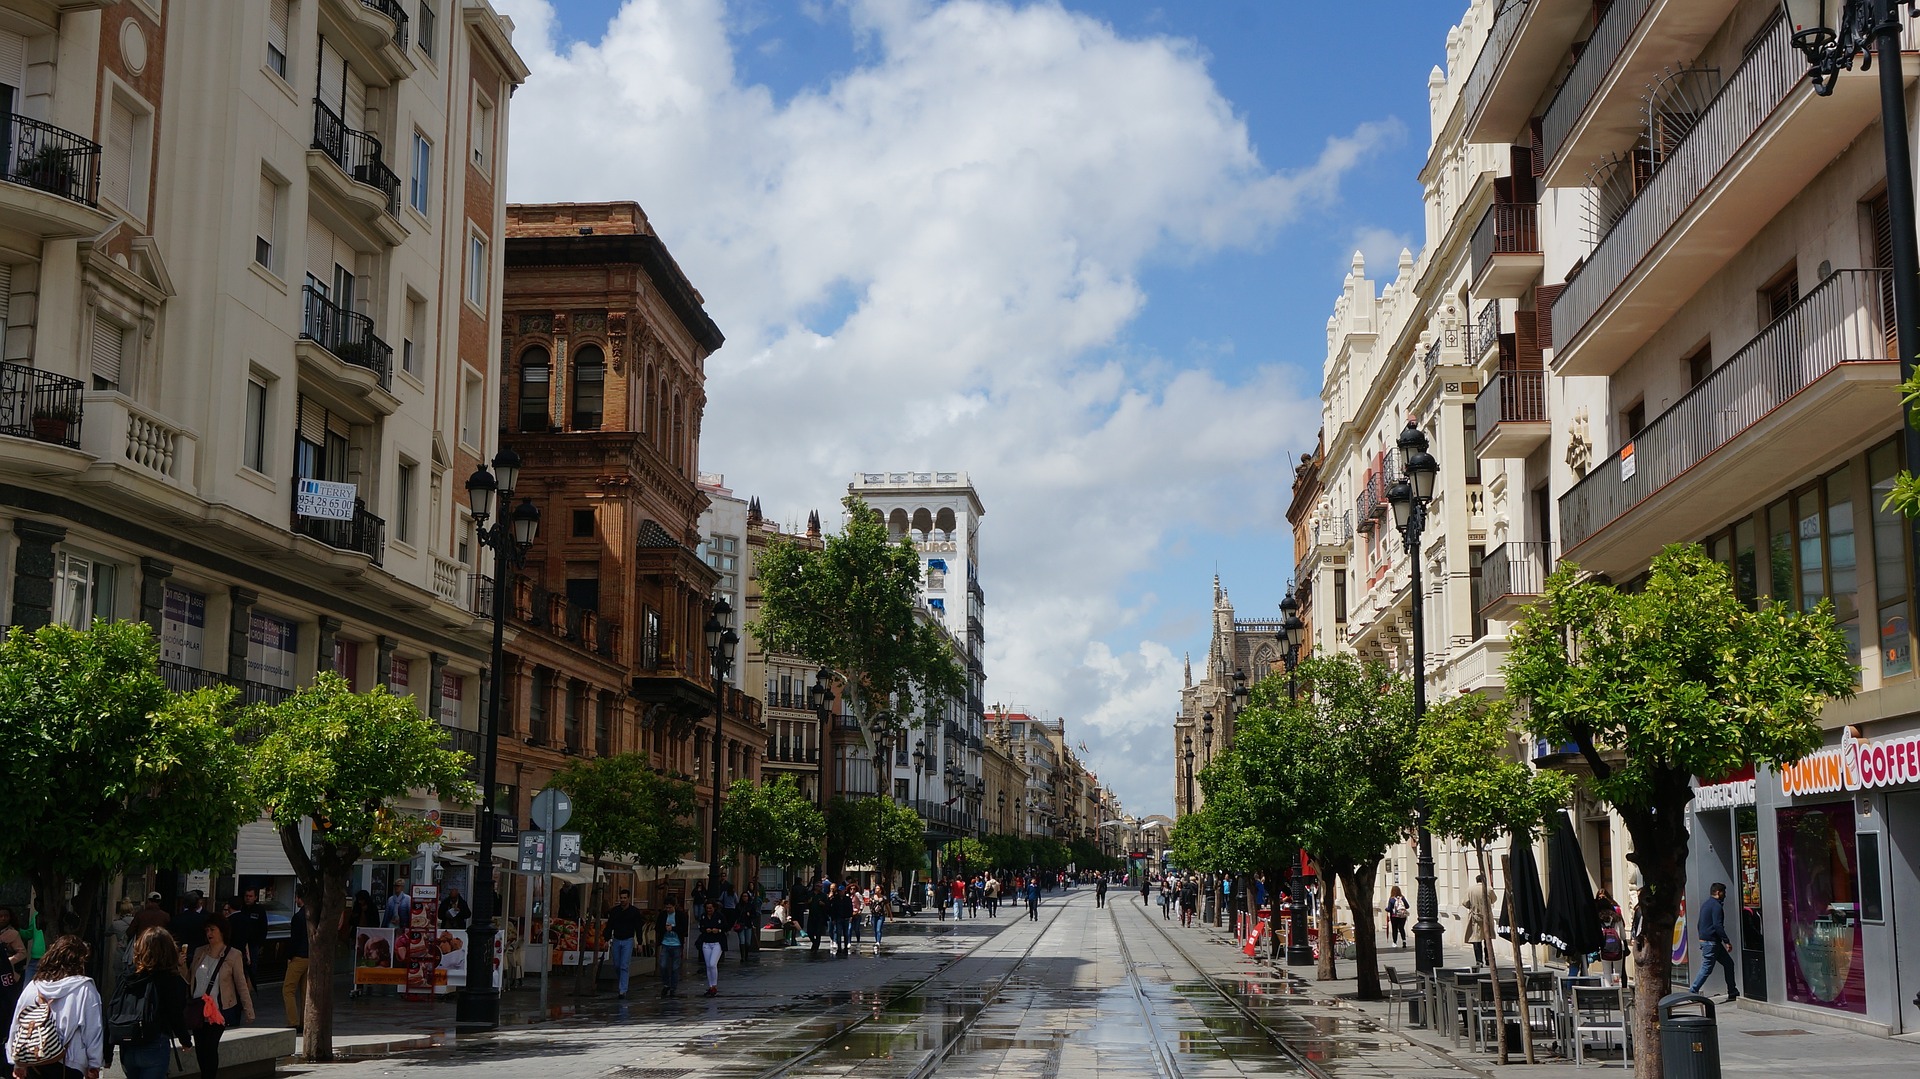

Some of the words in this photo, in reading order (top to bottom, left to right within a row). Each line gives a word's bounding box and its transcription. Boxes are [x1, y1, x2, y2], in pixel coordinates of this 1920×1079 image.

[320, 488, 353, 498] TERRY
[299, 495, 314, 505] 954
[317, 497, 327, 506] 28
[330, 499, 339, 508] 65
[342, 500, 352, 509] 00
[297, 505, 310, 513] SE
[314, 506, 351, 518] VENDE
[1695, 784, 1733, 808] BURGER
[1732, 779, 1756, 804] KING
